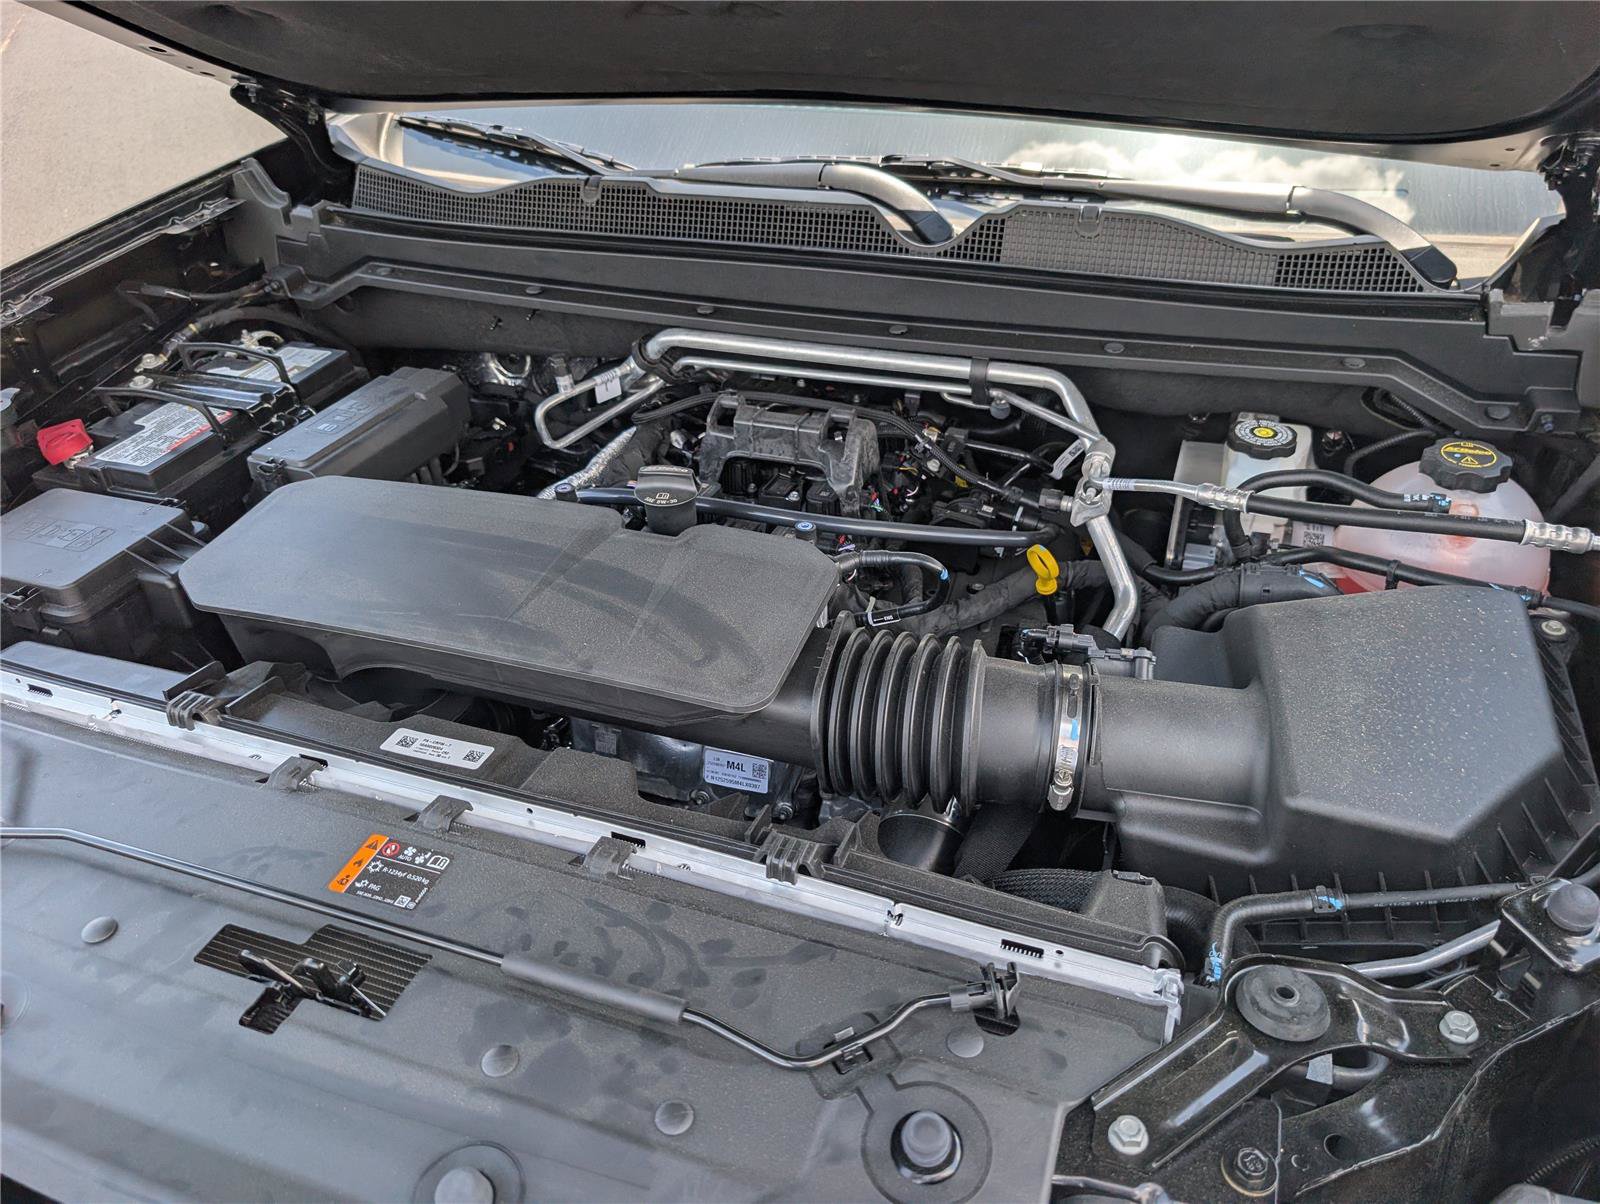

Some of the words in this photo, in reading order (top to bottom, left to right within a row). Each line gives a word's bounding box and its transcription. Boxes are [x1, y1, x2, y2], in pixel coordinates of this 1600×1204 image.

[726, 760, 746, 773] M4L
[397, 854, 412, 862] AUTO
[368, 883, 381, 892] PAG
